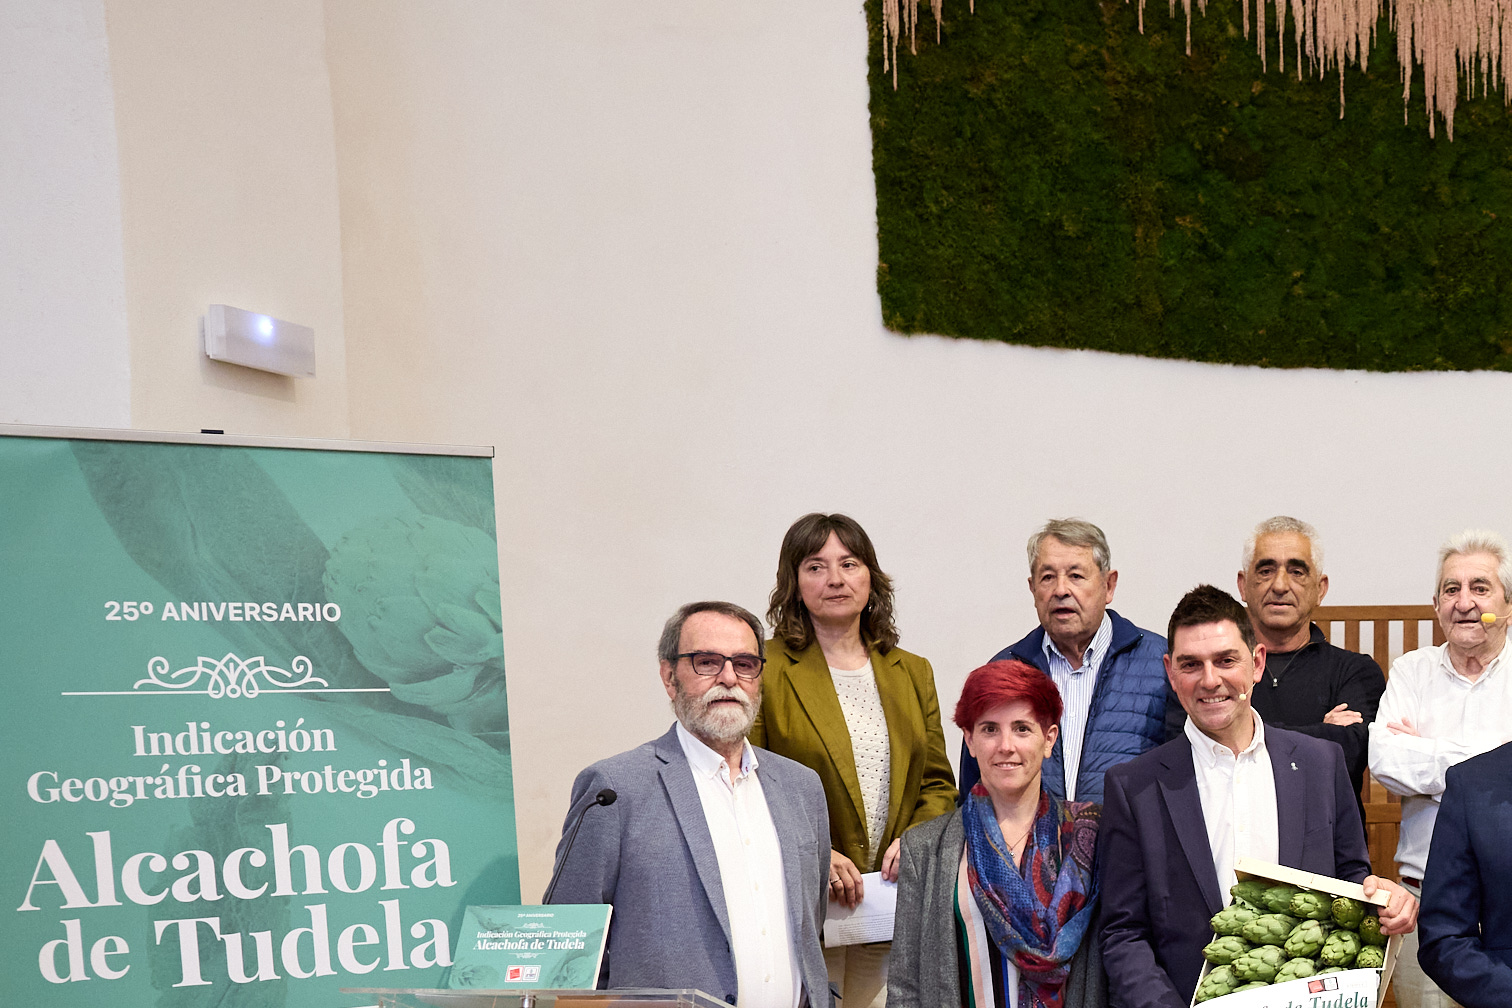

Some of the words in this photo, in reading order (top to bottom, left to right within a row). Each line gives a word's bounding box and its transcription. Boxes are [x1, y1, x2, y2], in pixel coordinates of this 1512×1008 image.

[161, 601, 342, 623] ANIVERSARIO
[131, 718, 337, 757] Indicación
[26, 764, 248, 809] Geográfica
[256, 758, 434, 798] Protegida
[16, 817, 457, 913] Alcachofa
[38, 918, 131, 985] de
[153, 898, 454, 989] Tudela
[473, 939, 528, 951] Alcachofa
[530, 939, 545, 950] de
[546, 938, 585, 950] Tudela
[477, 930, 513, 939] Indicación
[514, 930, 552, 940] Geográfica
[553, 930, 587, 940] Protegida
